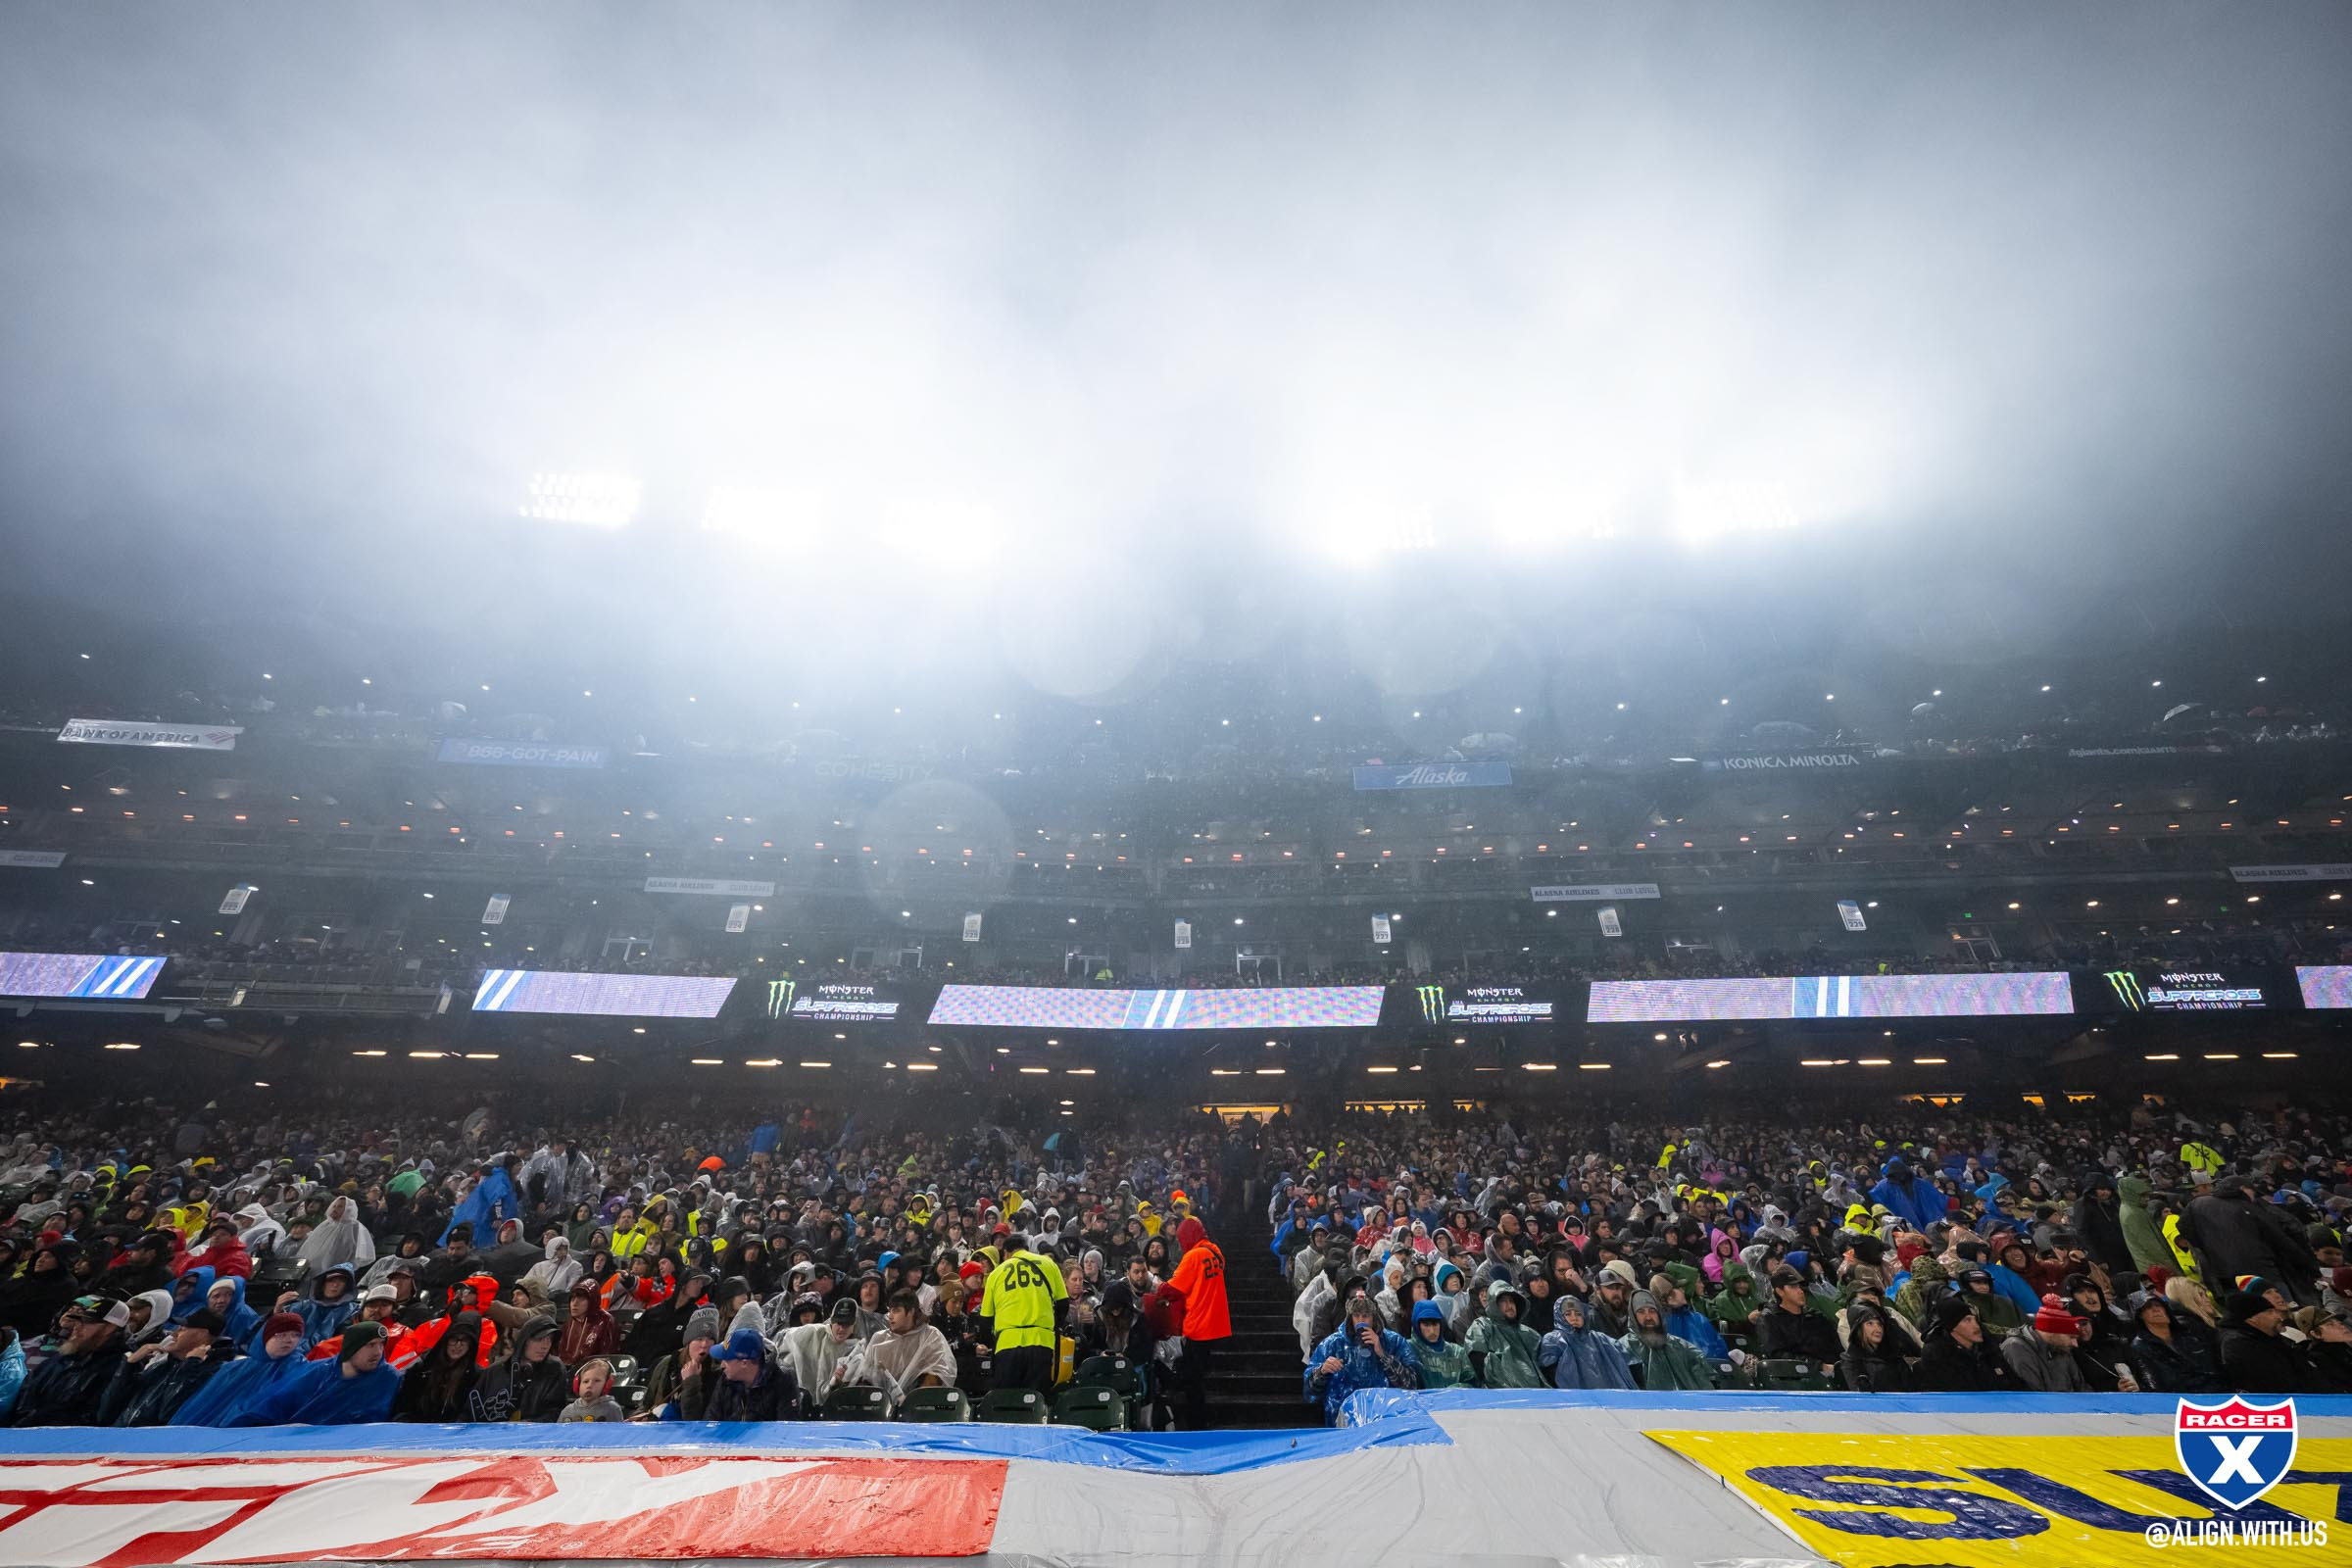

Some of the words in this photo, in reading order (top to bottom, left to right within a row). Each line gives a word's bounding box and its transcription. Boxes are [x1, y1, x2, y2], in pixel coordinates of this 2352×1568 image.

[62, 726, 109, 739] BANK
[112, 729, 129, 740] OF
[130, 731, 200, 744] AMERICA
[1723, 757, 1788, 769] KONICA
[1789, 754, 1860, 767] MINOLTA
[1396, 765, 1468, 785] Alaska
[2160, 972, 2226, 983] MONSTER
[818, 984, 874, 995] MONSTER
[1467, 987, 1524, 998] MONSTER
[2148, 989, 2262, 1003] SUPERCROSS
[792, 1001, 900, 1014] SUPERCROSS
[1447, 1003, 1553, 1016] SUPERCROSS
[813, 1012, 874, 1021] CHAMPIONSHIP
[1004, 1260, 1043, 1292] 265
